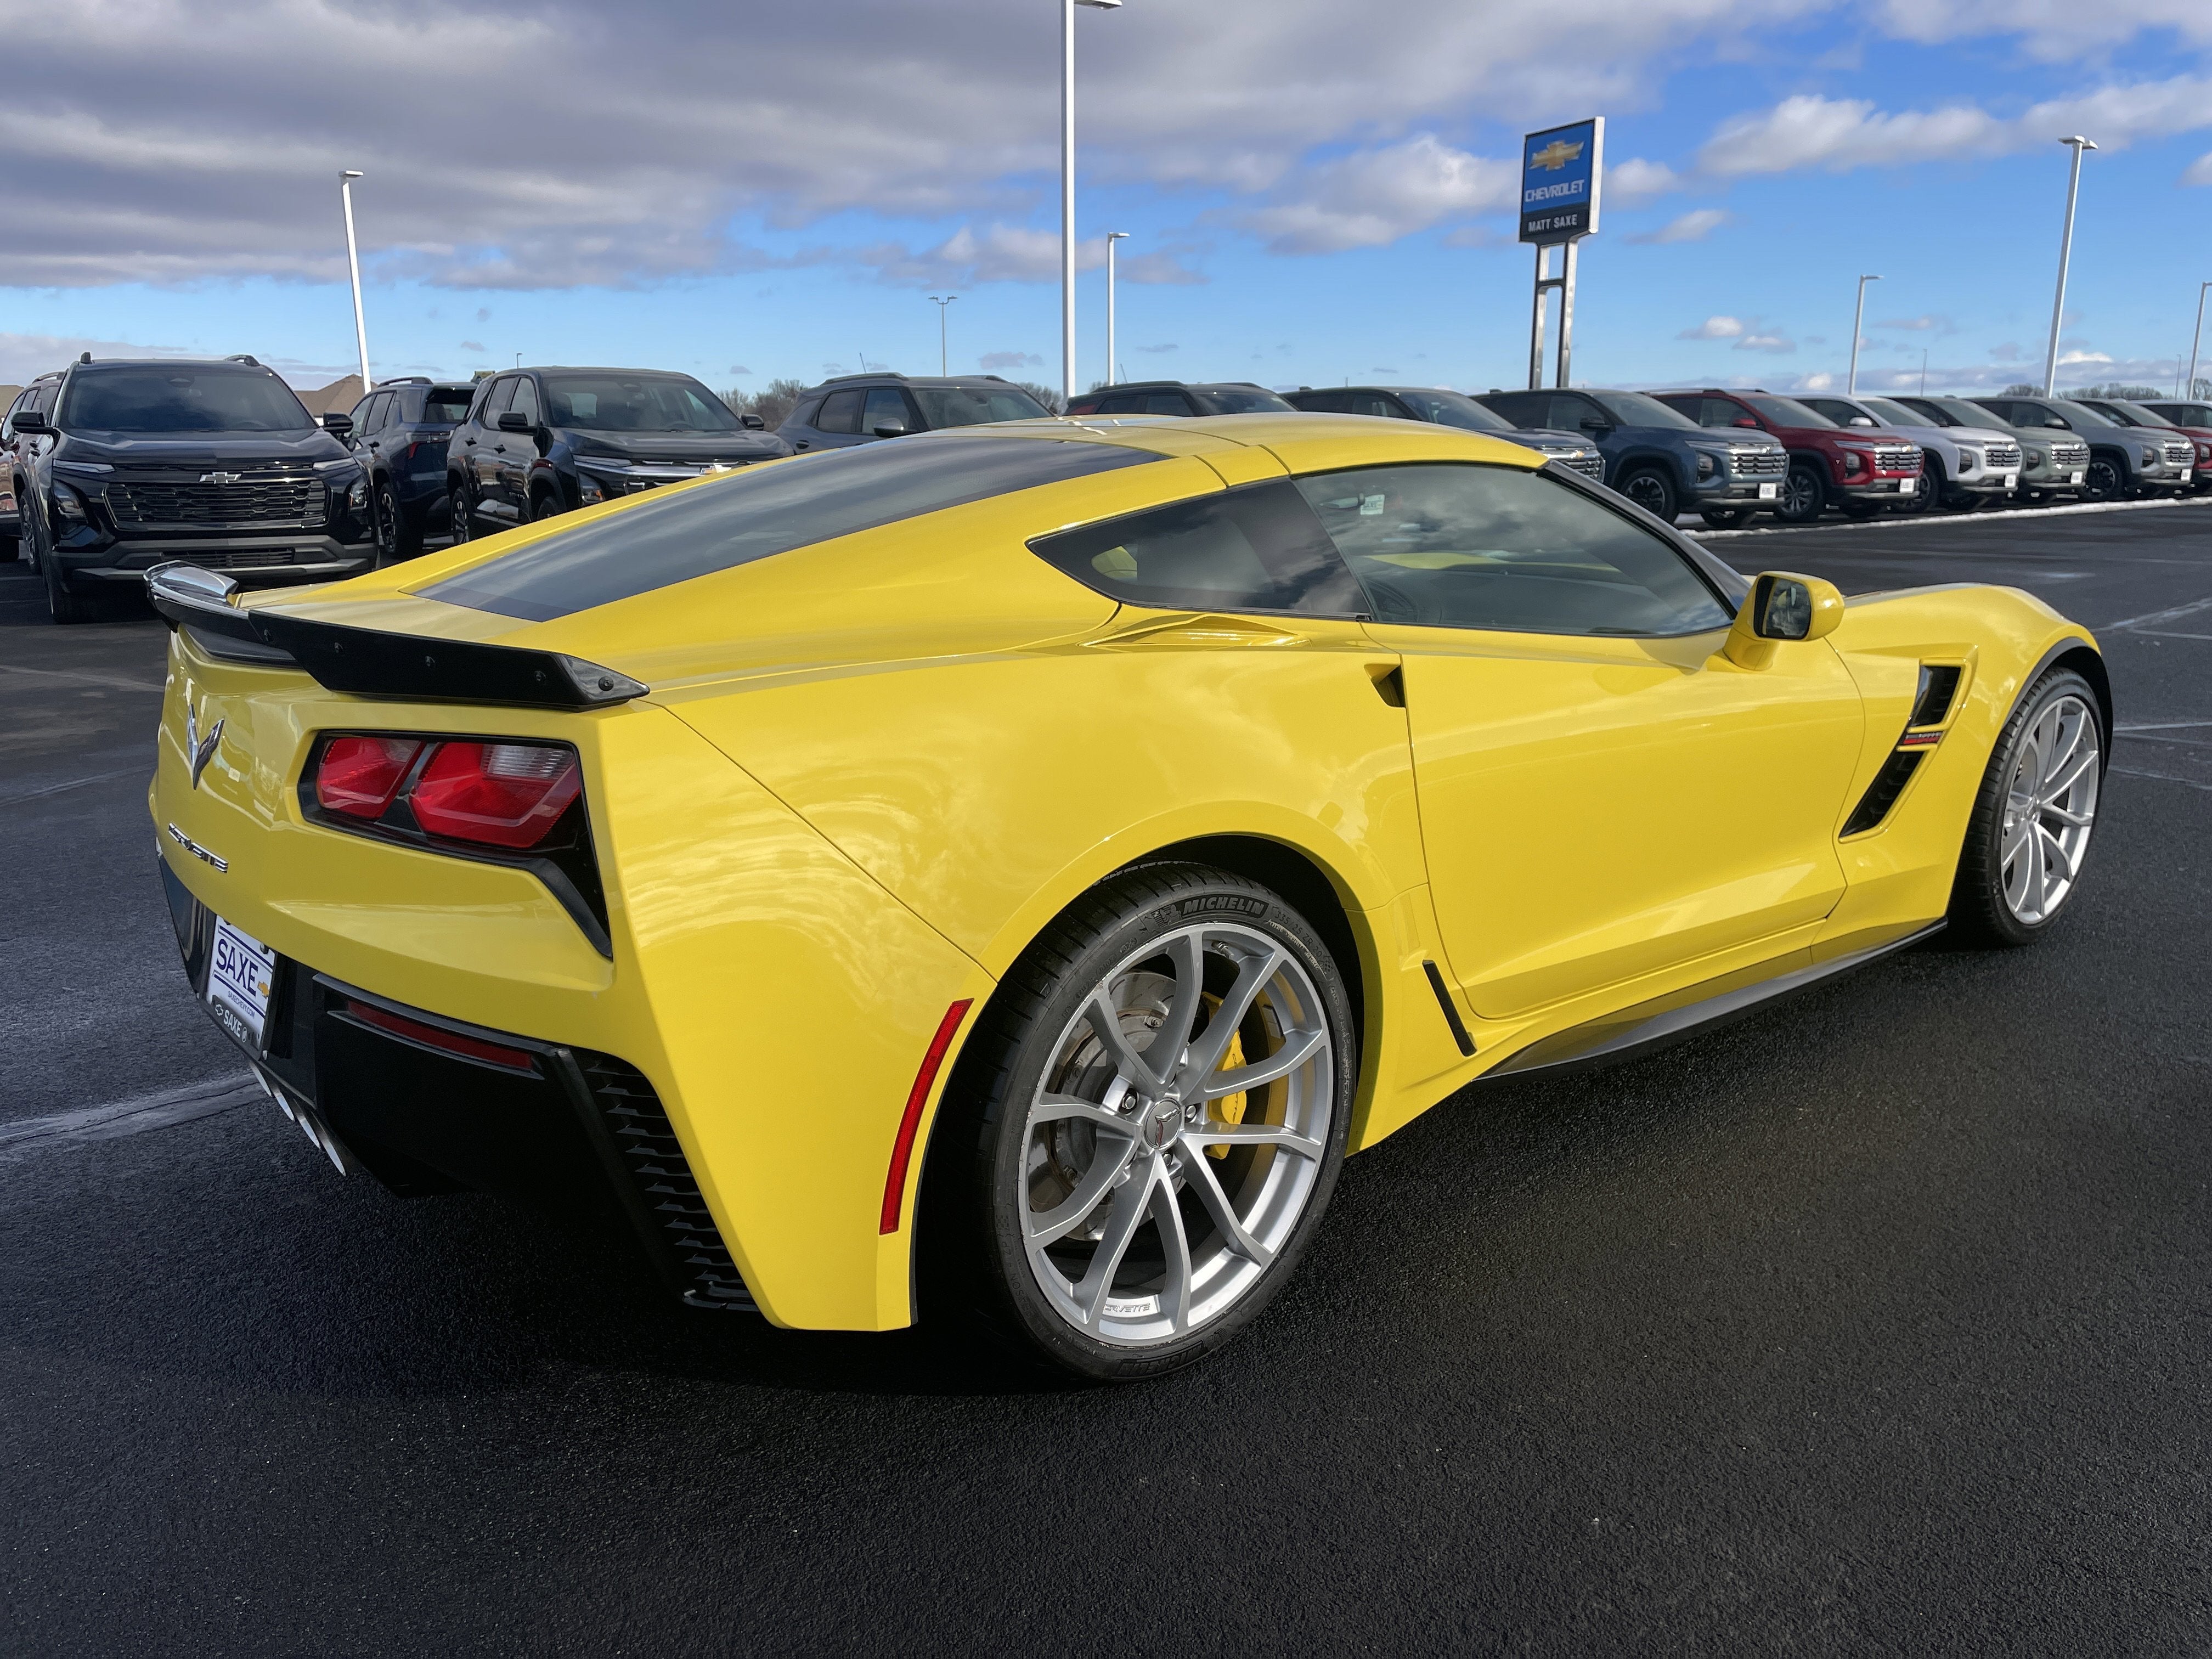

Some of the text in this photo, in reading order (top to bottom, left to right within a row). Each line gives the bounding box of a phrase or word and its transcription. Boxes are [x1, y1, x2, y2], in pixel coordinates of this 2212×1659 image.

[1525, 179, 1585, 202] CHEVROLET
[1528, 214, 1578, 233] MATT SAXE
[1183, 896, 1265, 915] MICHELIN
[216, 939, 258, 997] SAXE
[223, 1009, 242, 1038] SAXE
